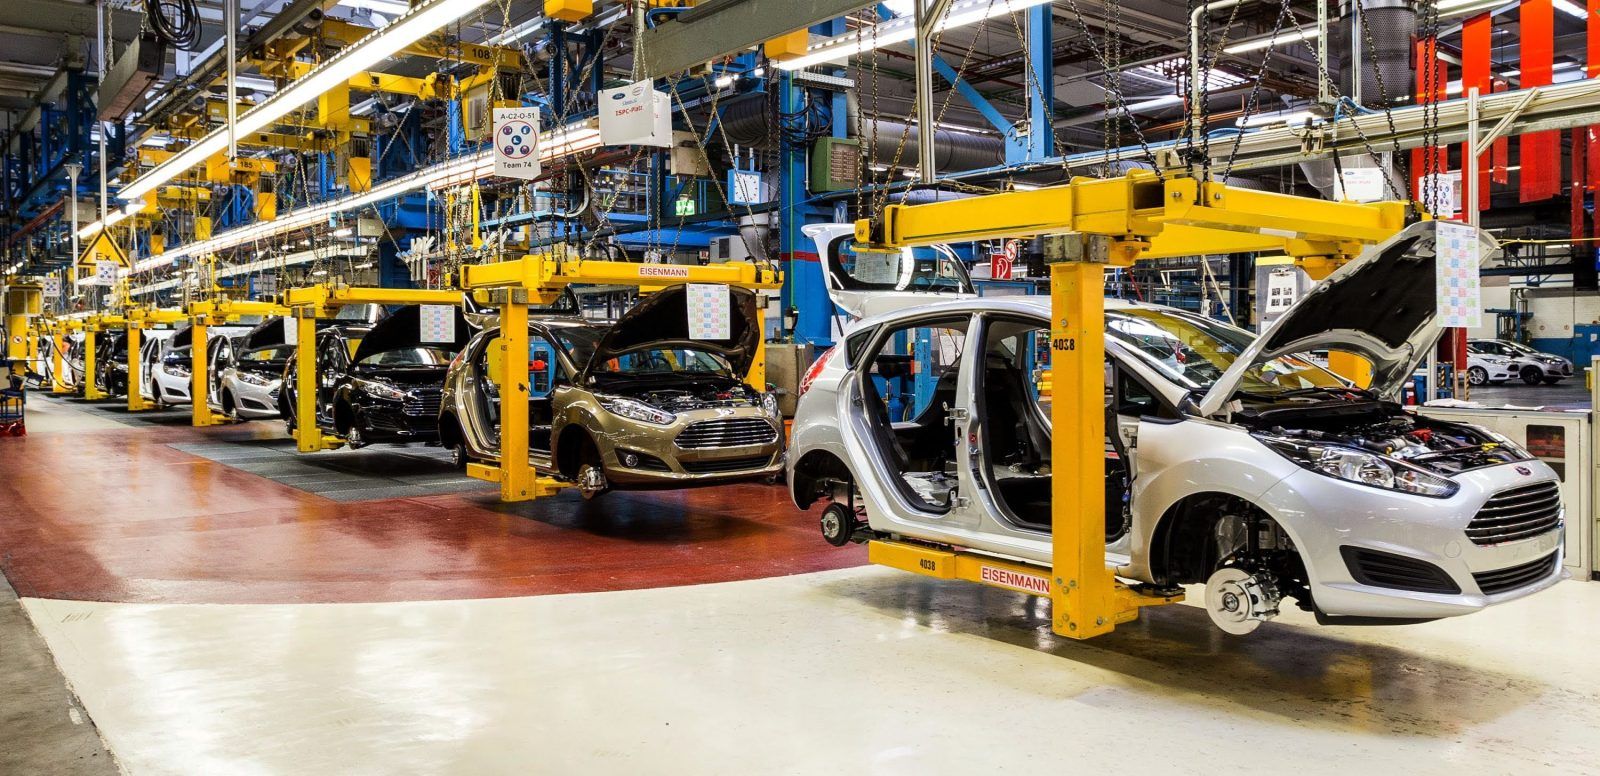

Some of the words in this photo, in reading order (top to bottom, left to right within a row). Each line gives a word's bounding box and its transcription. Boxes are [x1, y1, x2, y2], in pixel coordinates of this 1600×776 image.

[472, 48, 490, 59] 108
[95, 252, 111, 261] Ex
[640, 267, 688, 277] EISENMANN
[1053, 338, 1075, 351] 4038
[919, 558, 936, 571] 4038
[982, 567, 1050, 593] EISENMANN
